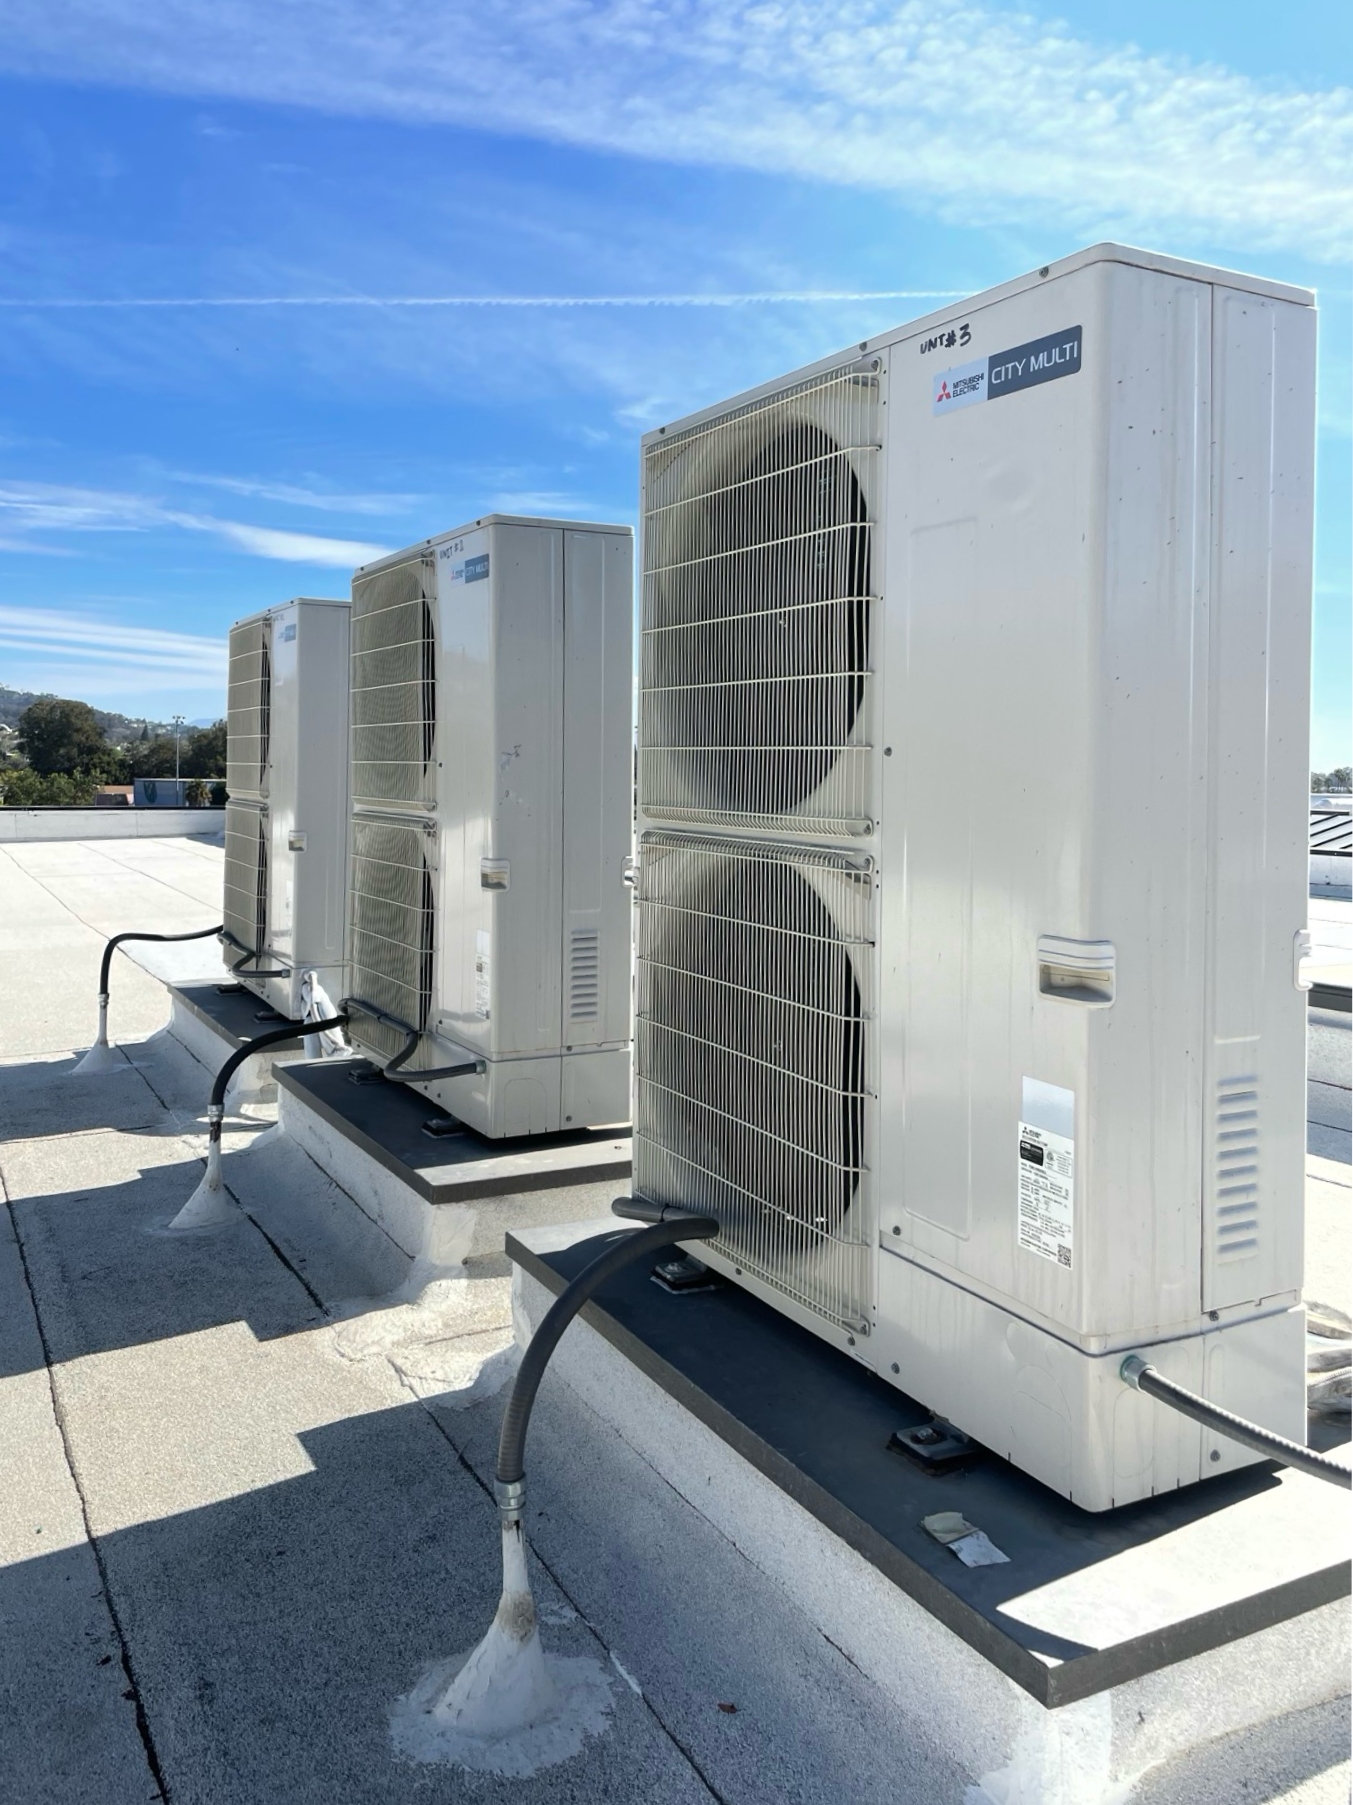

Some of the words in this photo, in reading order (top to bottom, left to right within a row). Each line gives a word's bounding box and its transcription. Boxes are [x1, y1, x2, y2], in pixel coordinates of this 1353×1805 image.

[991, 358, 1027, 384] CITY
[1030, 341, 1078, 373] MULTI
[952, 373, 985, 389] MITSUBISHI
[952, 382, 980, 398] ELECTRIC
